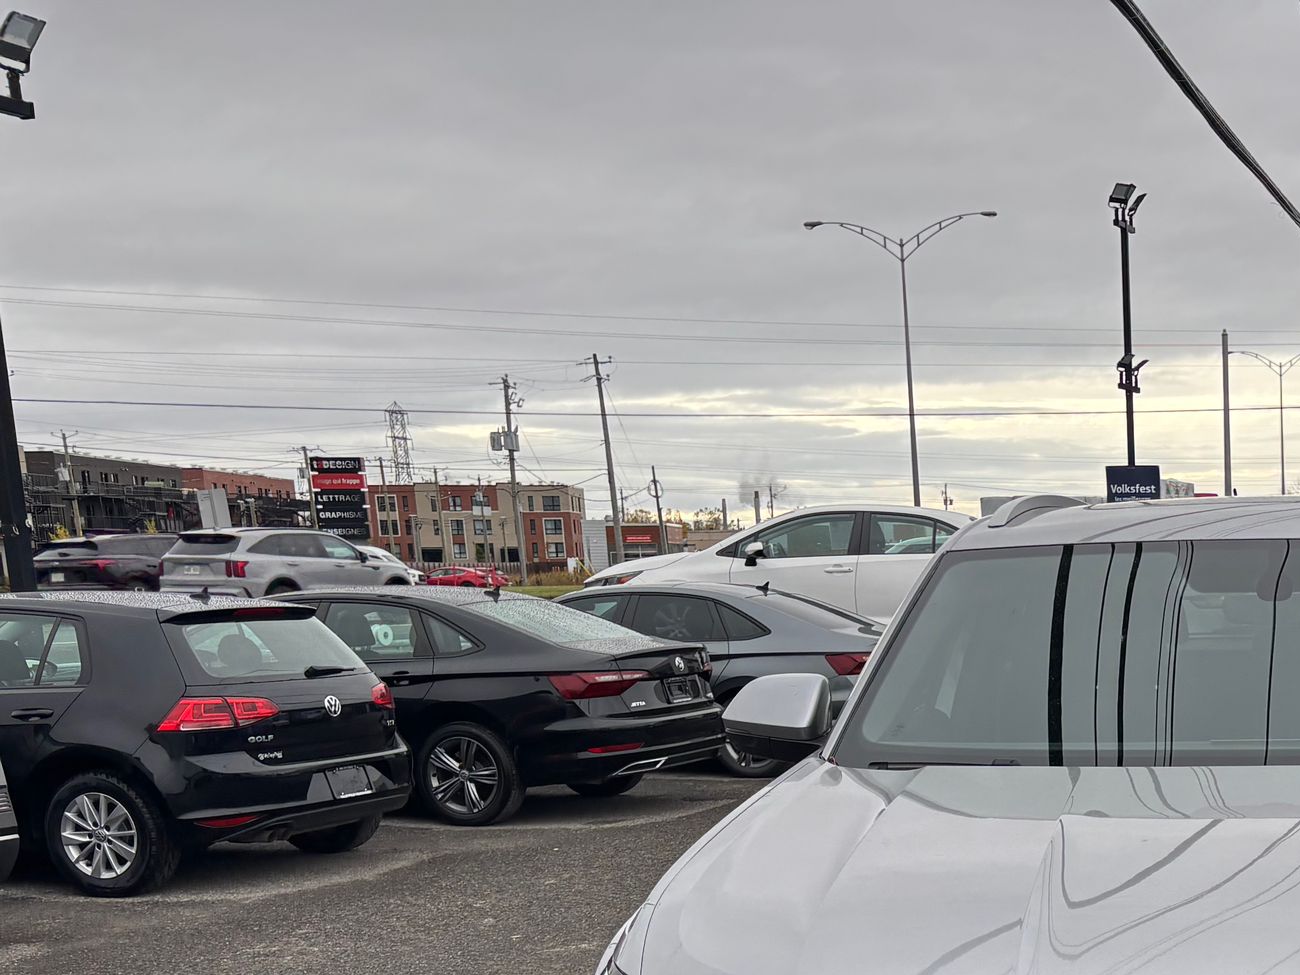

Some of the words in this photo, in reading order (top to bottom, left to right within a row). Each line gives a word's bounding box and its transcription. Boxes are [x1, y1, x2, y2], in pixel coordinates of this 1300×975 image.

[1110, 483, 1157, 494] Volksfest
[317, 494, 361, 502] LETTRAGE
[319, 511, 365, 519] GRAPHISME
[247, 734, 274, 744] GOLF
